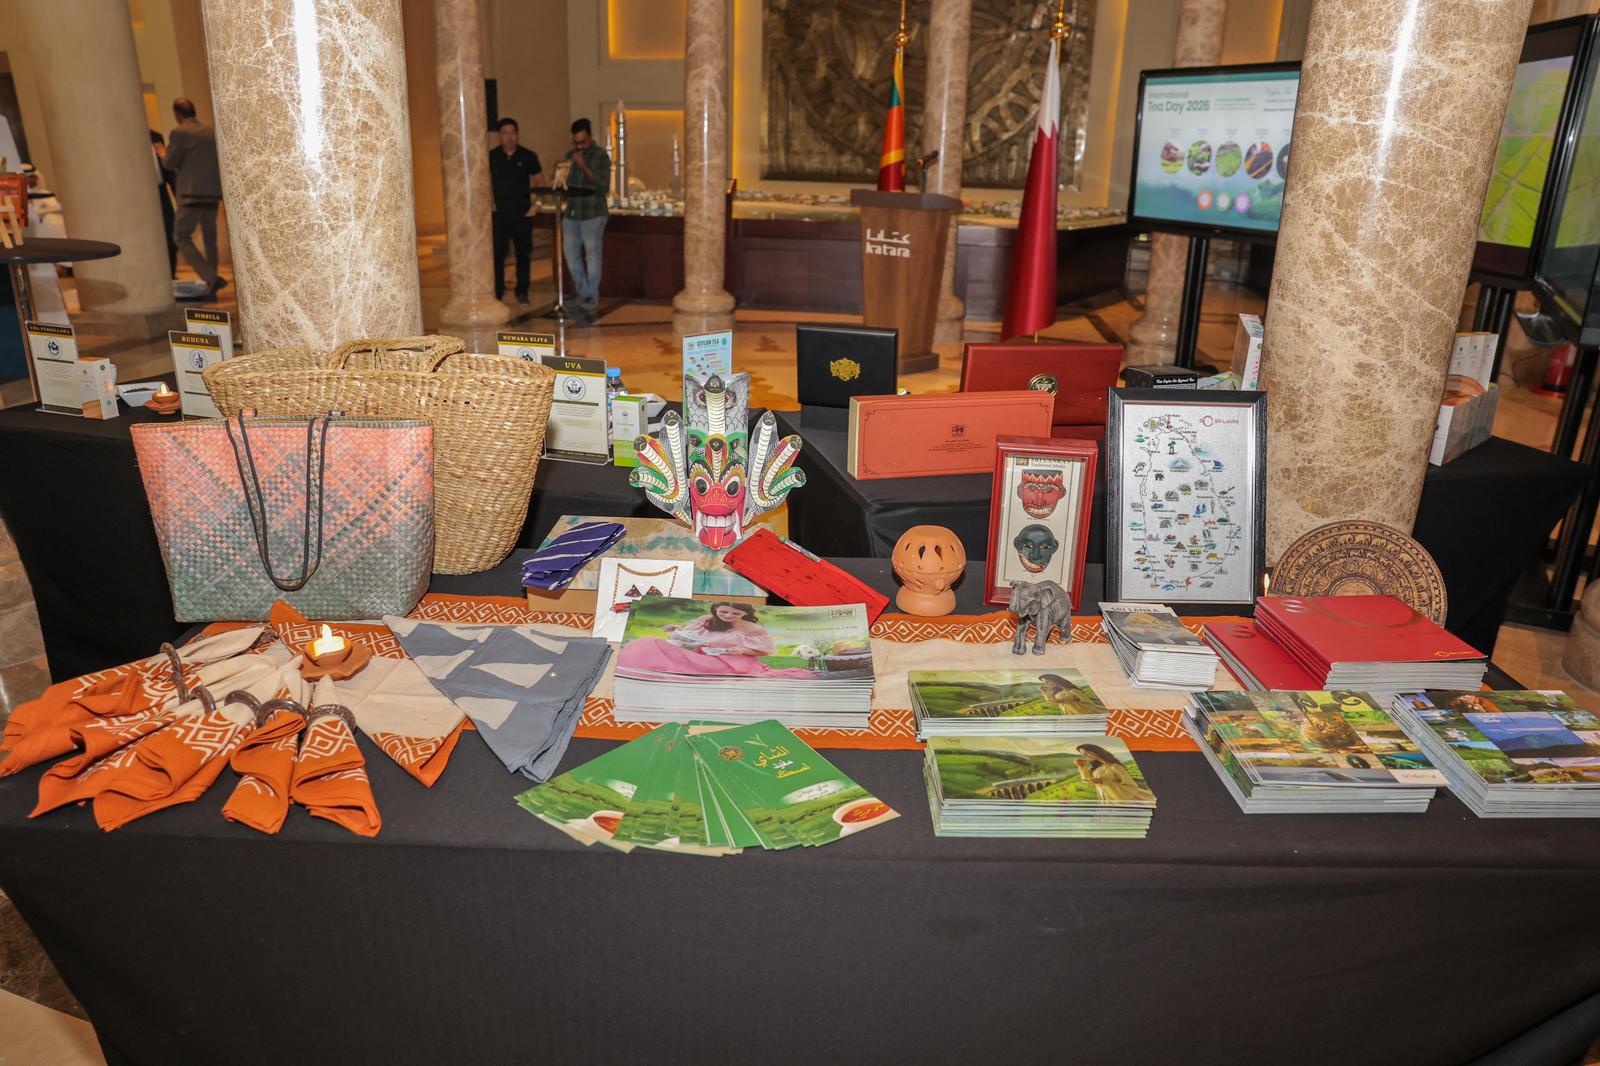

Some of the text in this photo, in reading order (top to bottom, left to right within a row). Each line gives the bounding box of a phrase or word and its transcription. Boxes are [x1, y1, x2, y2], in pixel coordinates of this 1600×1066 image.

[1148, 101, 1164, 112] Tea
[1165, 101, 1184, 115] Day
[1186, 100, 1210, 112] 2026
[866, 242, 910, 257] katara
[181, 336, 209, 344] RUHUNA
[565, 362, 582, 370] UVA
